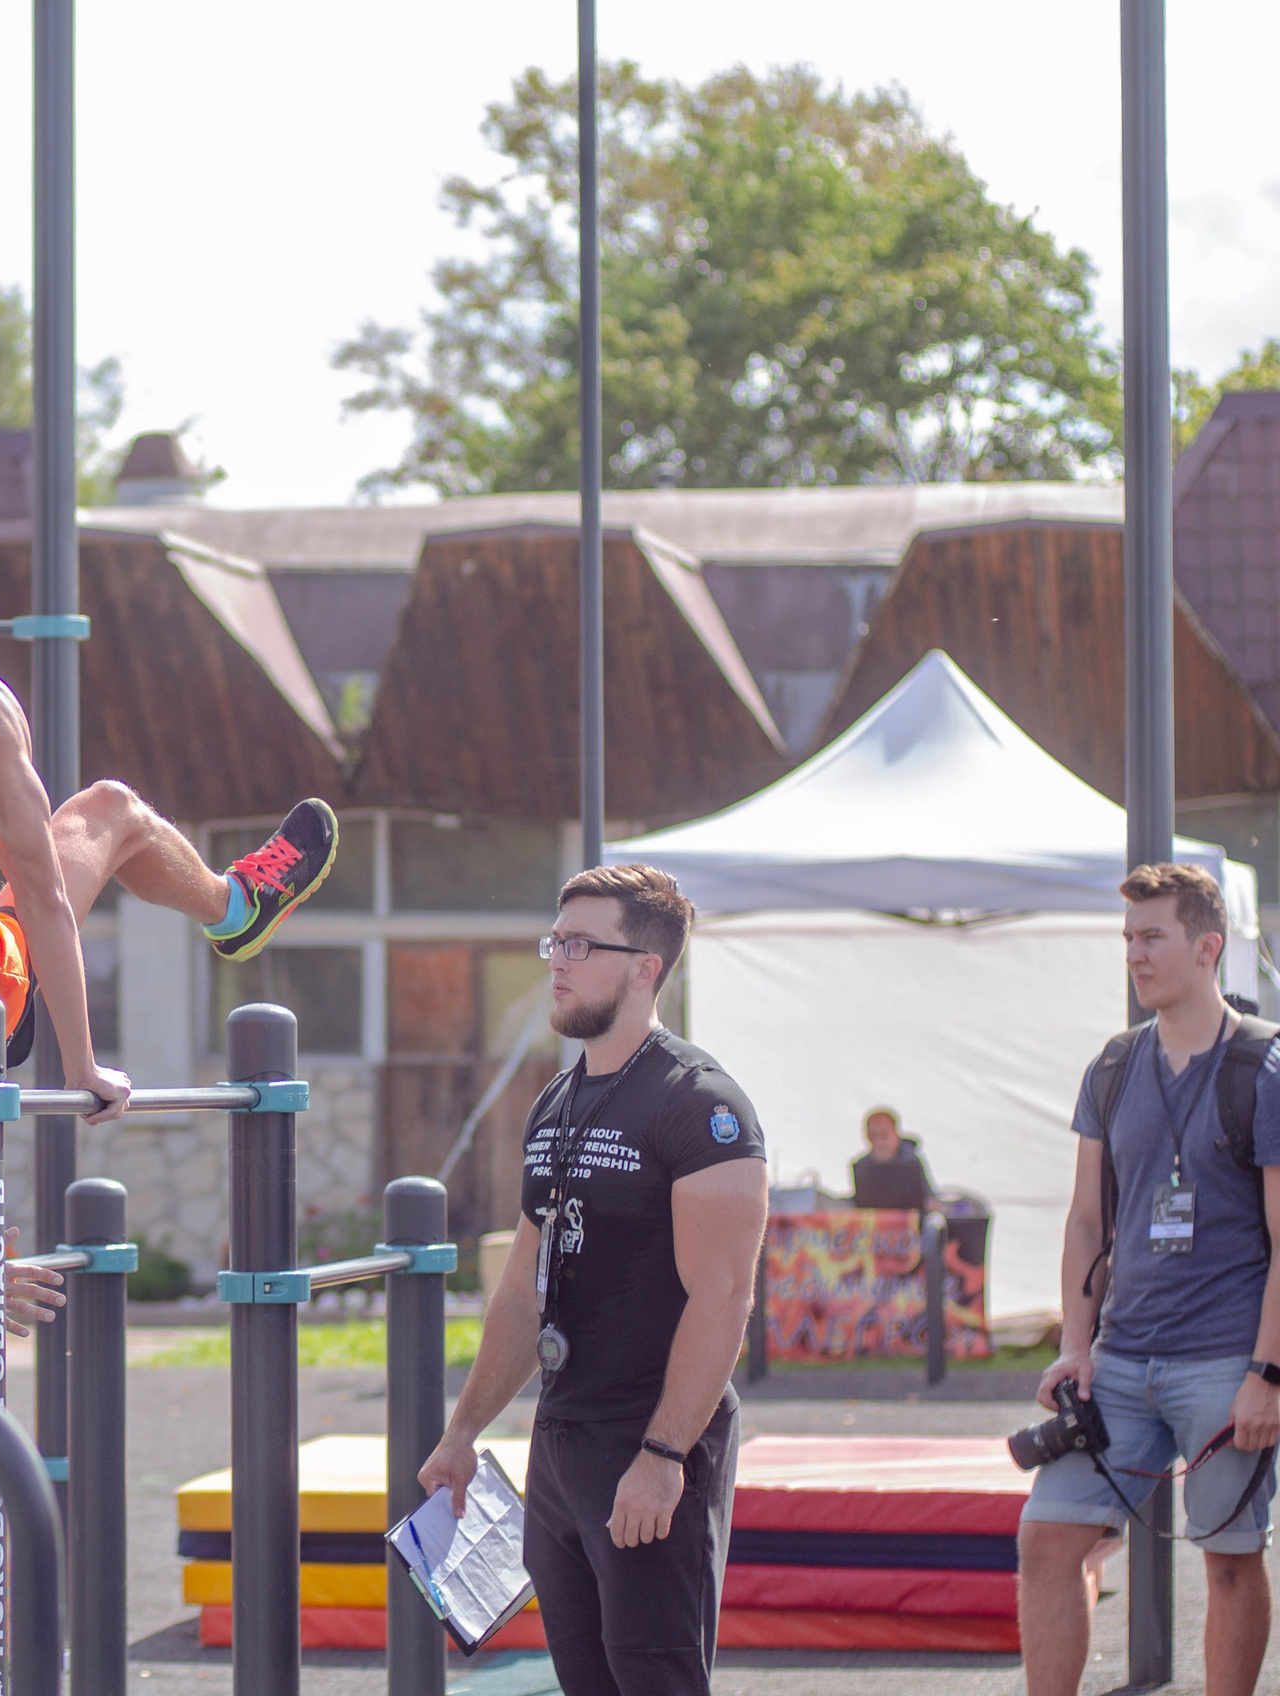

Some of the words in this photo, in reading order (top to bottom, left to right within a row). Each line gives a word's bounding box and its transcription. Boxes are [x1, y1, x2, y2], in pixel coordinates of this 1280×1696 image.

[536, 1127, 563, 1139] STREE
[524, 1153, 545, 1165] ORLD
[531, 1166, 553, 1177] PSK
